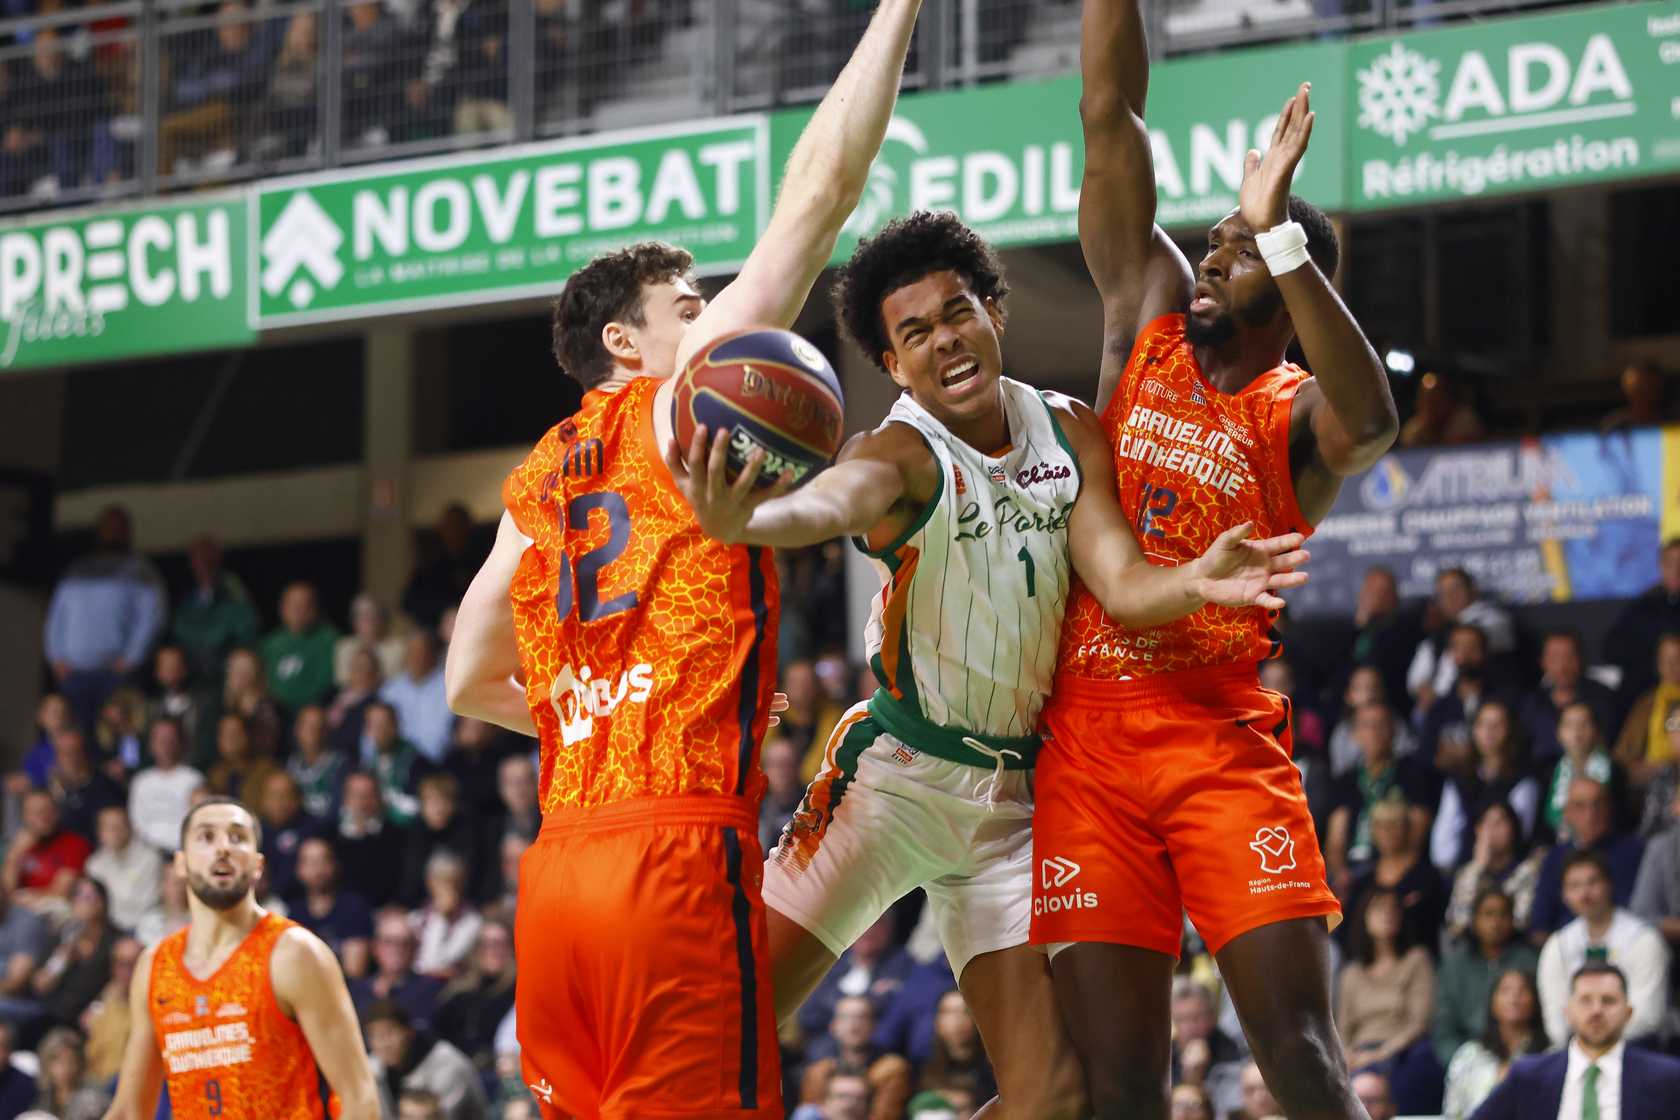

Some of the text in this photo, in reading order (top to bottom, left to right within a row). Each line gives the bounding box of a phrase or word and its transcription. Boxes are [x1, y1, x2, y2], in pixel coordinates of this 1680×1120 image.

[1443, 33, 1633, 122] ADA
[910, 112, 1304, 225] EDILAN
[1361, 136, 1639, 200] Réfrigération
[353, 141, 753, 263] NOVEBAT
[1119, 434, 1245, 499] DUNKERQUE
[954, 502, 992, 542] Le
[1017, 546, 1036, 598] 1
[1078, 643, 1153, 661] FRANCE
[205, 1079, 223, 1117] 9
